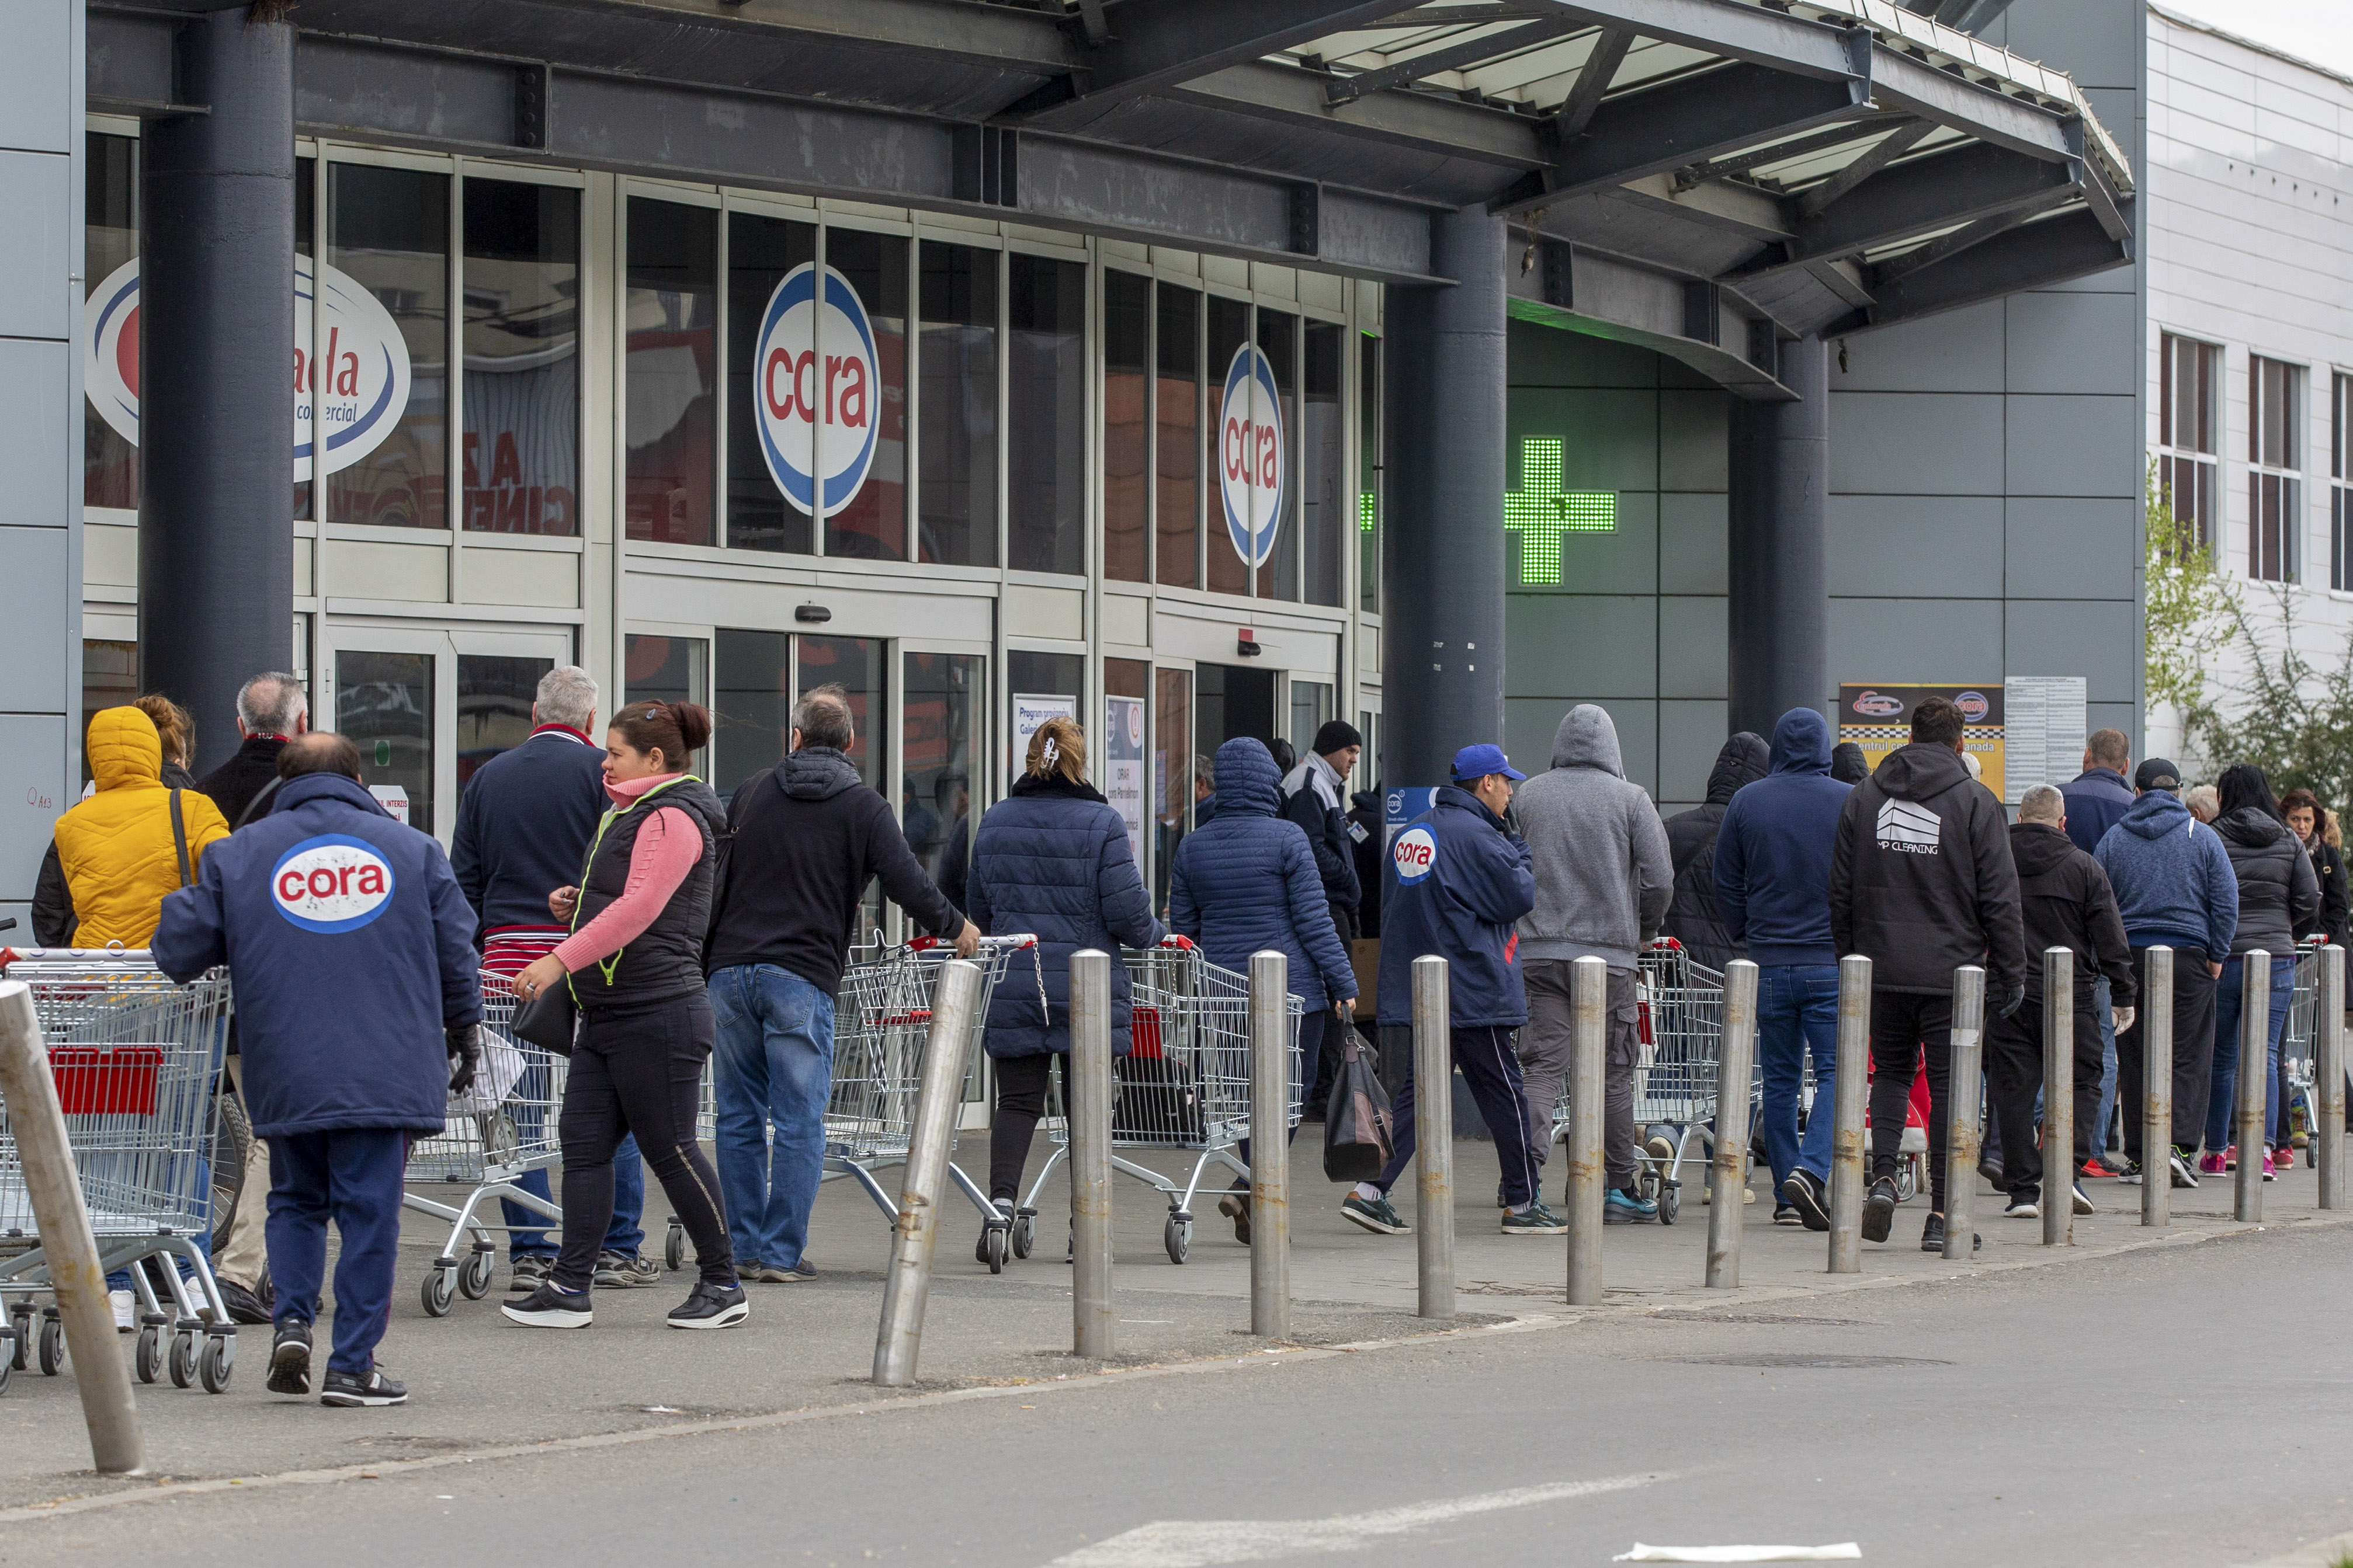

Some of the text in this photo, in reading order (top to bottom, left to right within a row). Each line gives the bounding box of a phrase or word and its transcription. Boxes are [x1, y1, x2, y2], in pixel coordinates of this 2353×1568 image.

[765, 347, 867, 428] cora
[297, 402, 358, 423] coercial
[1224, 416, 1277, 489] cora
[1019, 707, 1043, 721] Program
[1958, 701, 1986, 712] cora
[1964, 740, 1995, 752] anada
[386, 799, 408, 808] INTERZIS
[1395, 842, 1432, 867] cora
[1892, 842, 1938, 855] CLEANING
[278, 864, 386, 902] cora
